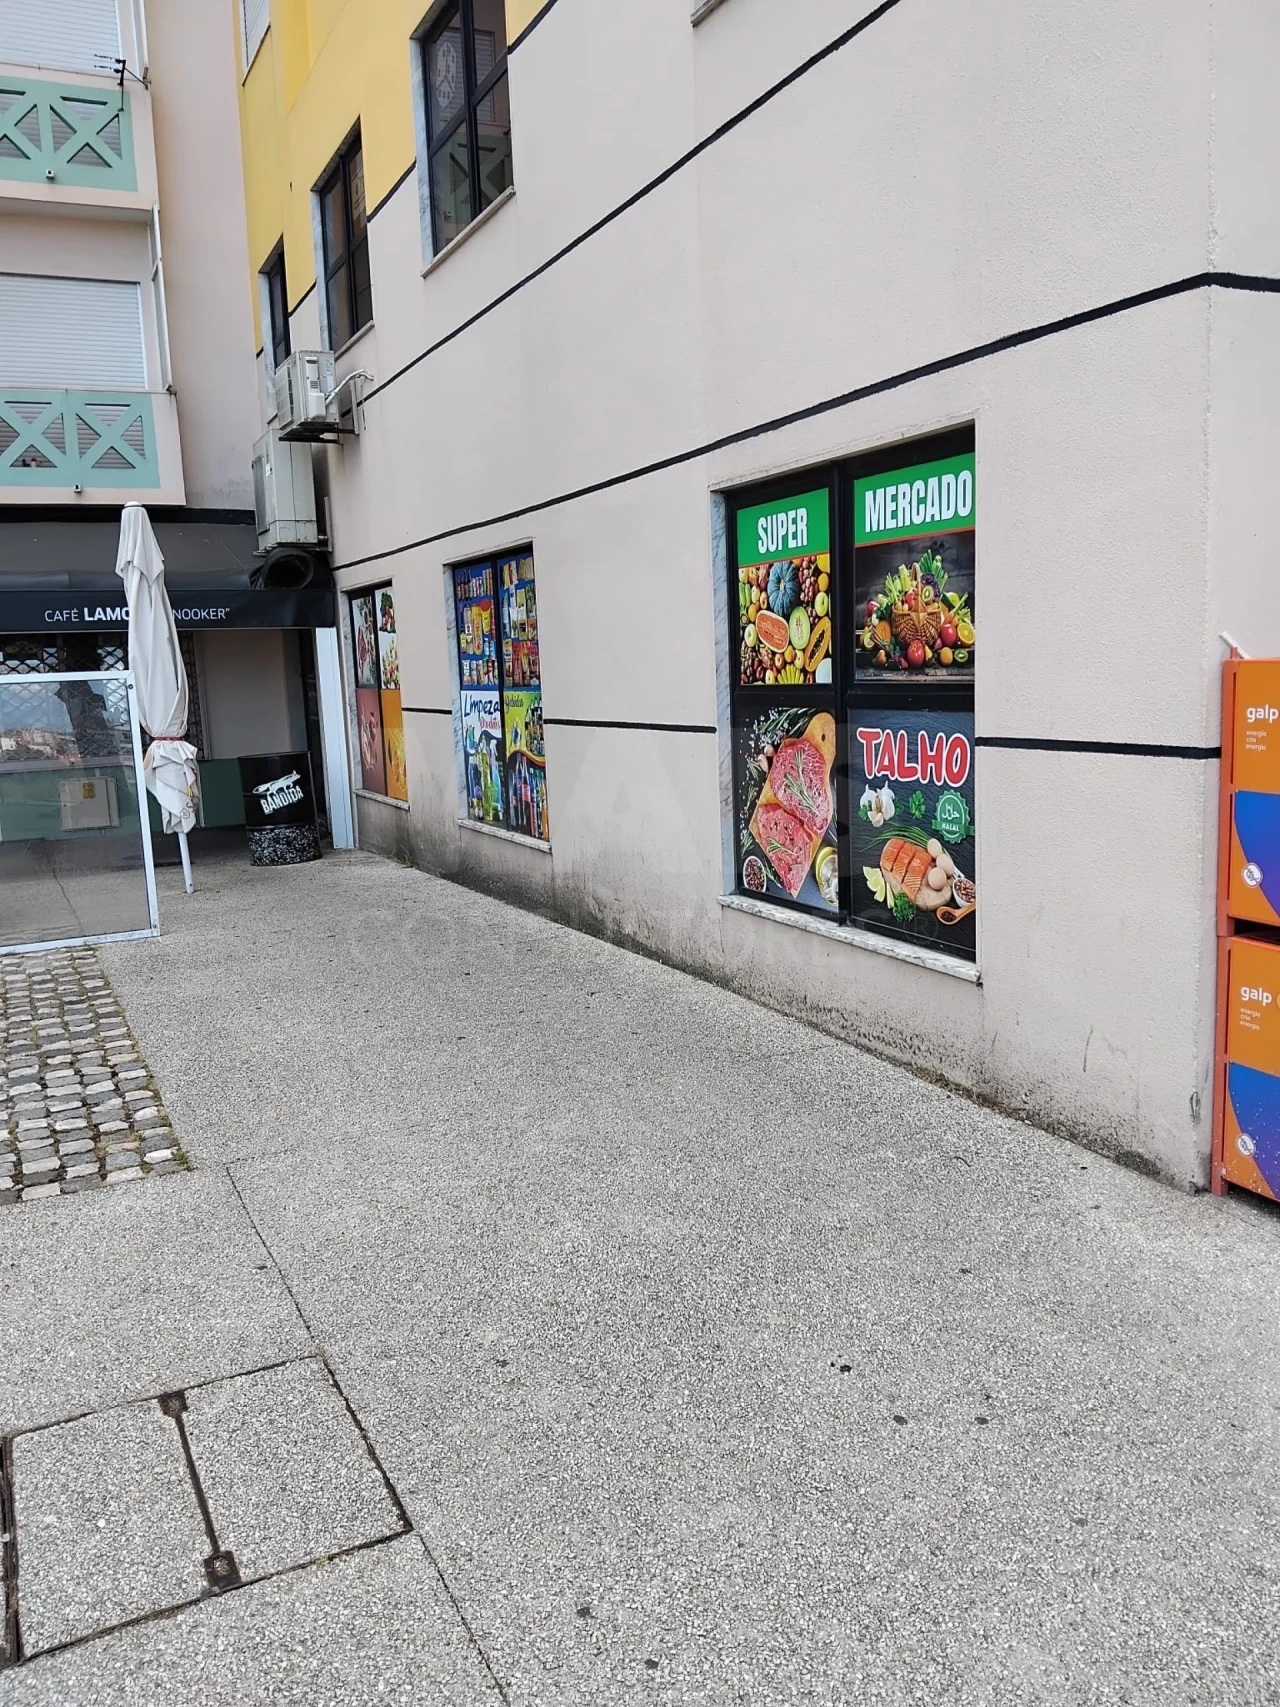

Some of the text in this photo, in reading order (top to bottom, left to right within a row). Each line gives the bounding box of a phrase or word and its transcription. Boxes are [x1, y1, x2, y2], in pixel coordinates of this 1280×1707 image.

[757, 469, 973, 555] SUPER MERCADO
[44, 608, 80, 622] CAFÉ
[464, 693, 501, 720] Limpeza
[1246, 704, 1279, 723] galp
[857, 728, 971, 787] TALHO
[941, 822, 960, 832] HALAL
[1241, 986, 1272, 1006] galp
